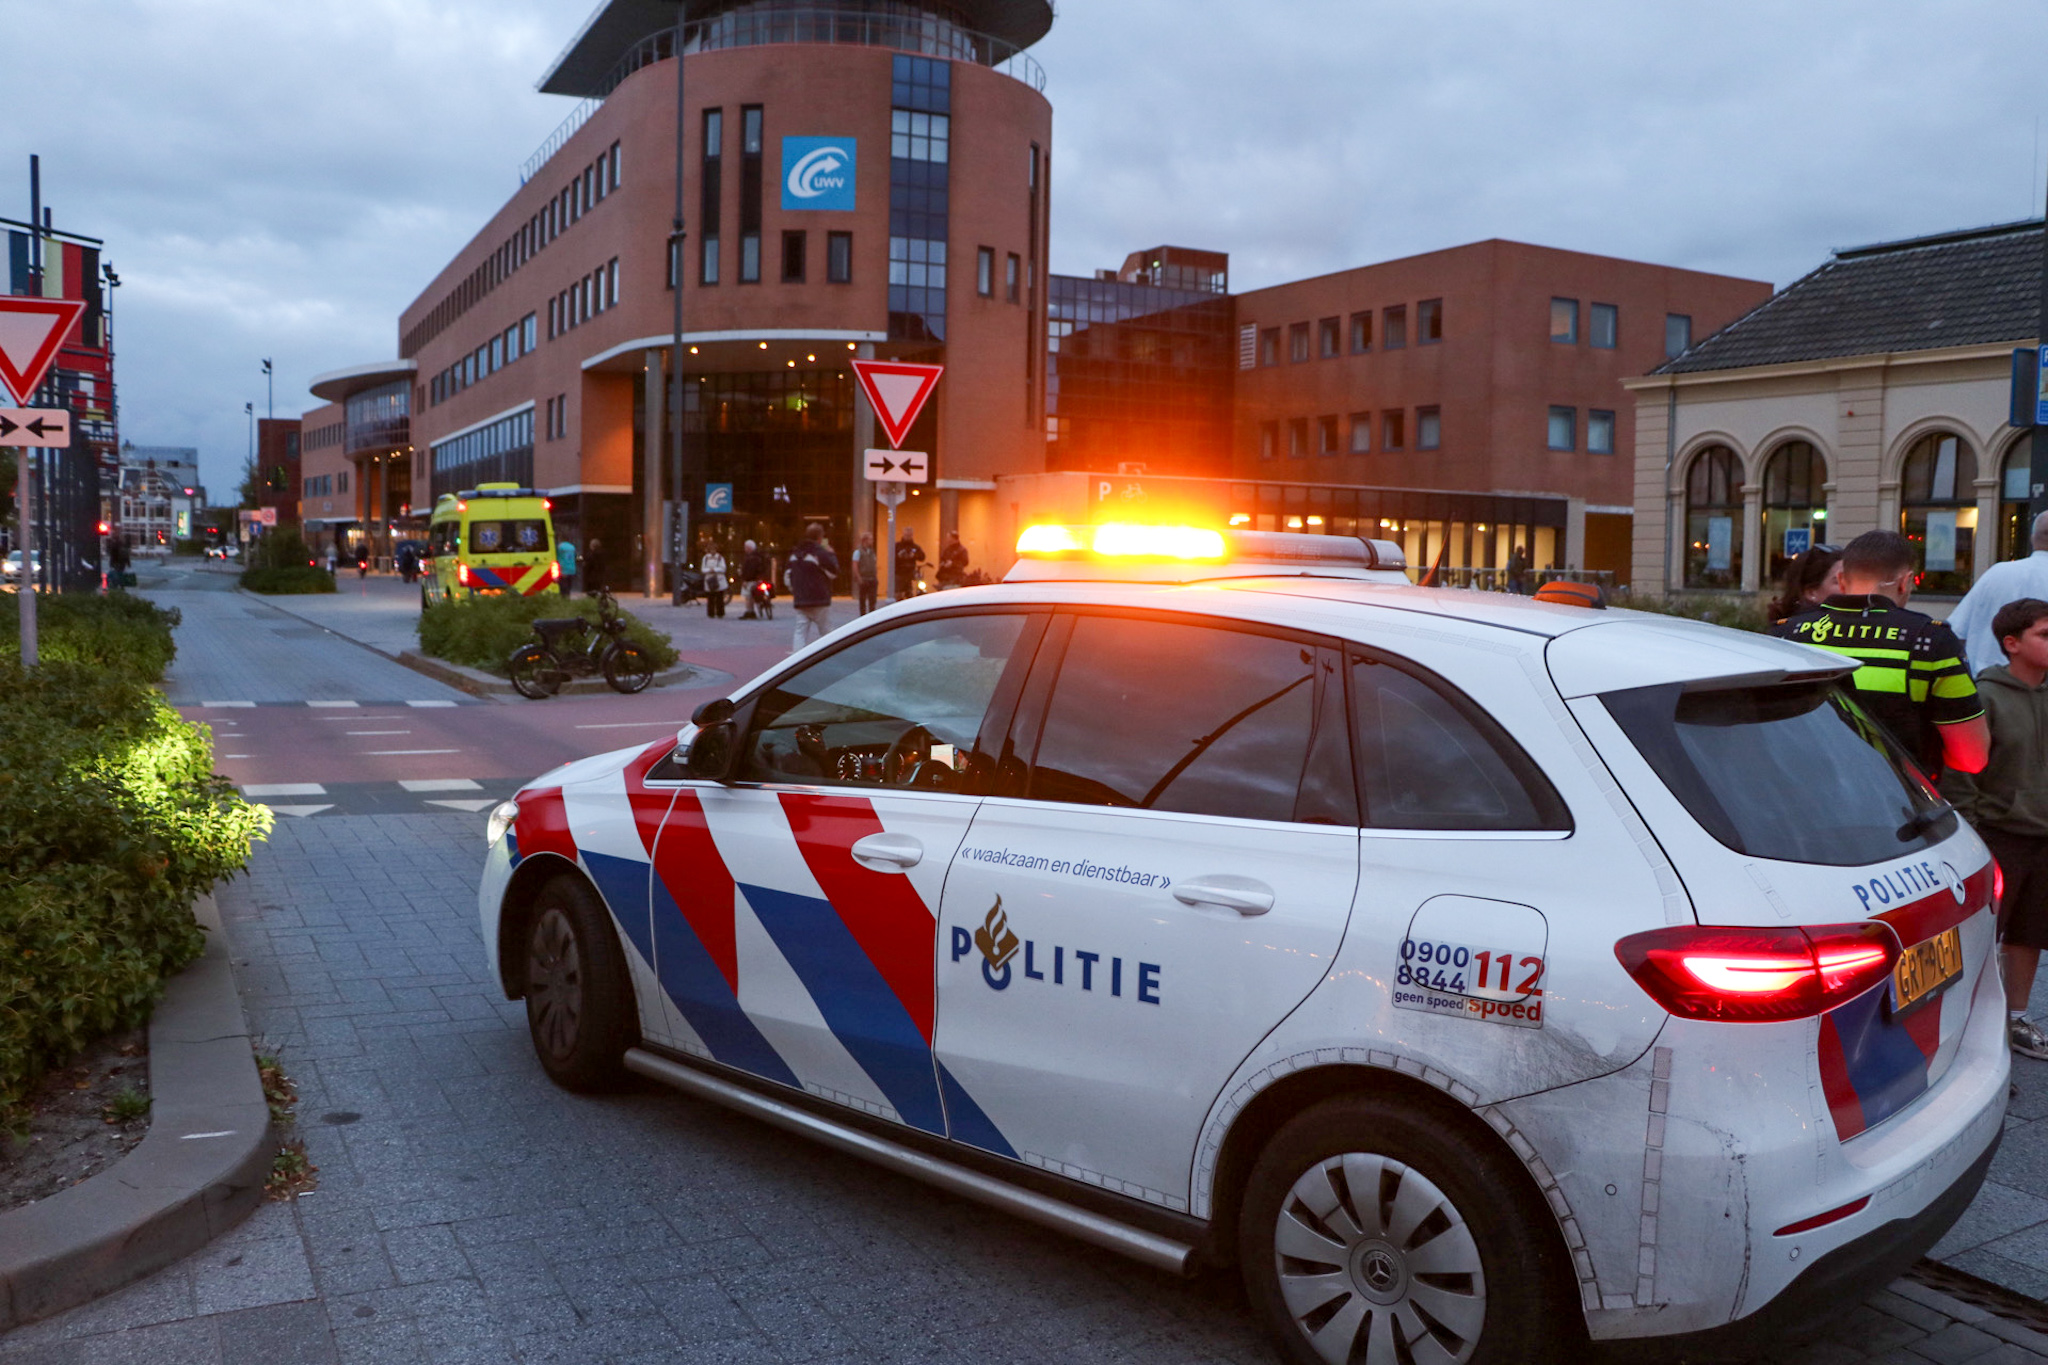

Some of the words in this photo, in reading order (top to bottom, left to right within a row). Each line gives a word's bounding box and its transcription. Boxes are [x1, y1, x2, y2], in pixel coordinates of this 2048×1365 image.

[1099, 481, 1112, 502] P
[973, 848, 1049, 871] waakzaam
[1051, 860, 1070, 874] en
[1072, 859, 1158, 887] dienstbaar
[1852, 861, 1940, 911] POLITIE
[951, 925, 1161, 1005] POLITIE
[1400, 939, 1470, 968] 0900
[1397, 965, 1466, 993] 8844
[1474, 950, 1545, 996] 112
[1394, 991, 1424, 1003] geen
[1426, 996, 1464, 1010] spoed
[1468, 999, 1542, 1022] spoed
